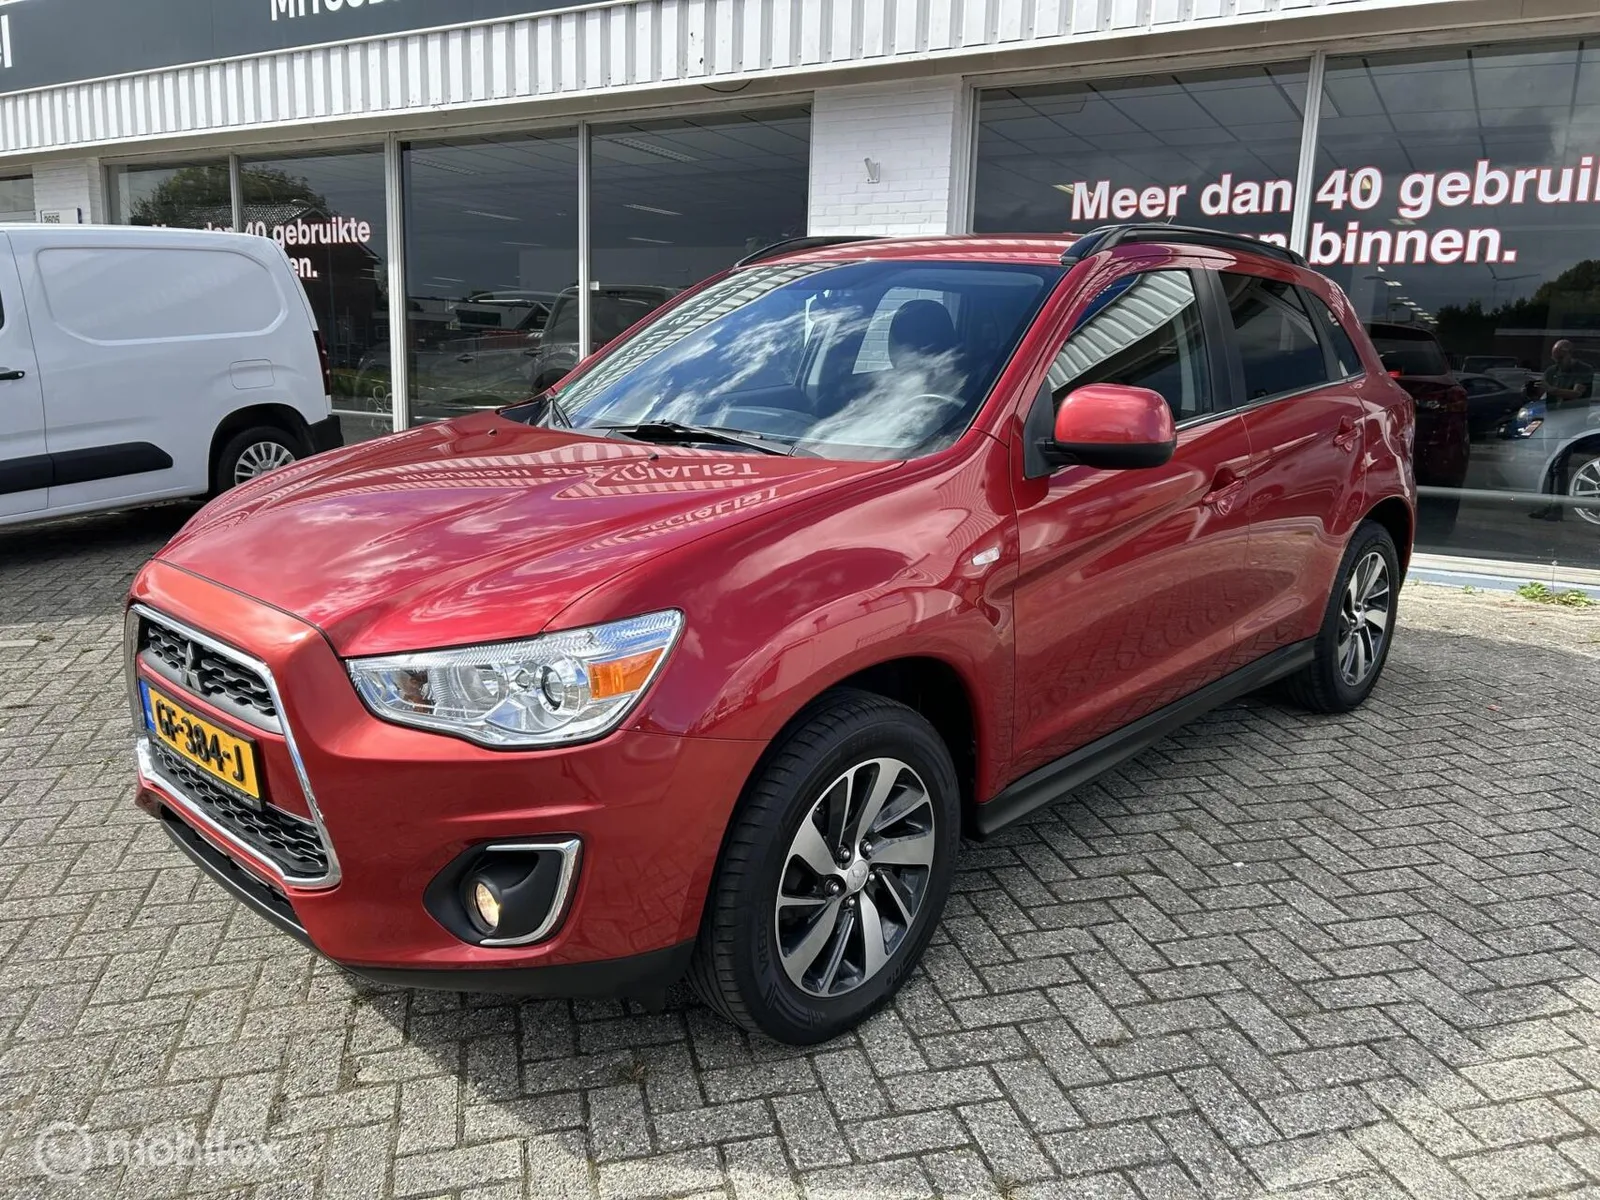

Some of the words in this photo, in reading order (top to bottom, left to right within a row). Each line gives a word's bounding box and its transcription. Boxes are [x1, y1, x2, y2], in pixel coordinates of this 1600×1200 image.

[1071, 180, 1188, 221] Meer
[1200, 172, 1293, 216] dan
[1315, 166, 1383, 211] 40
[1397, 155, 1600, 220] gebrui
[272, 215, 371, 250] gebruikte
[1308, 221, 1517, 265] binnen.
